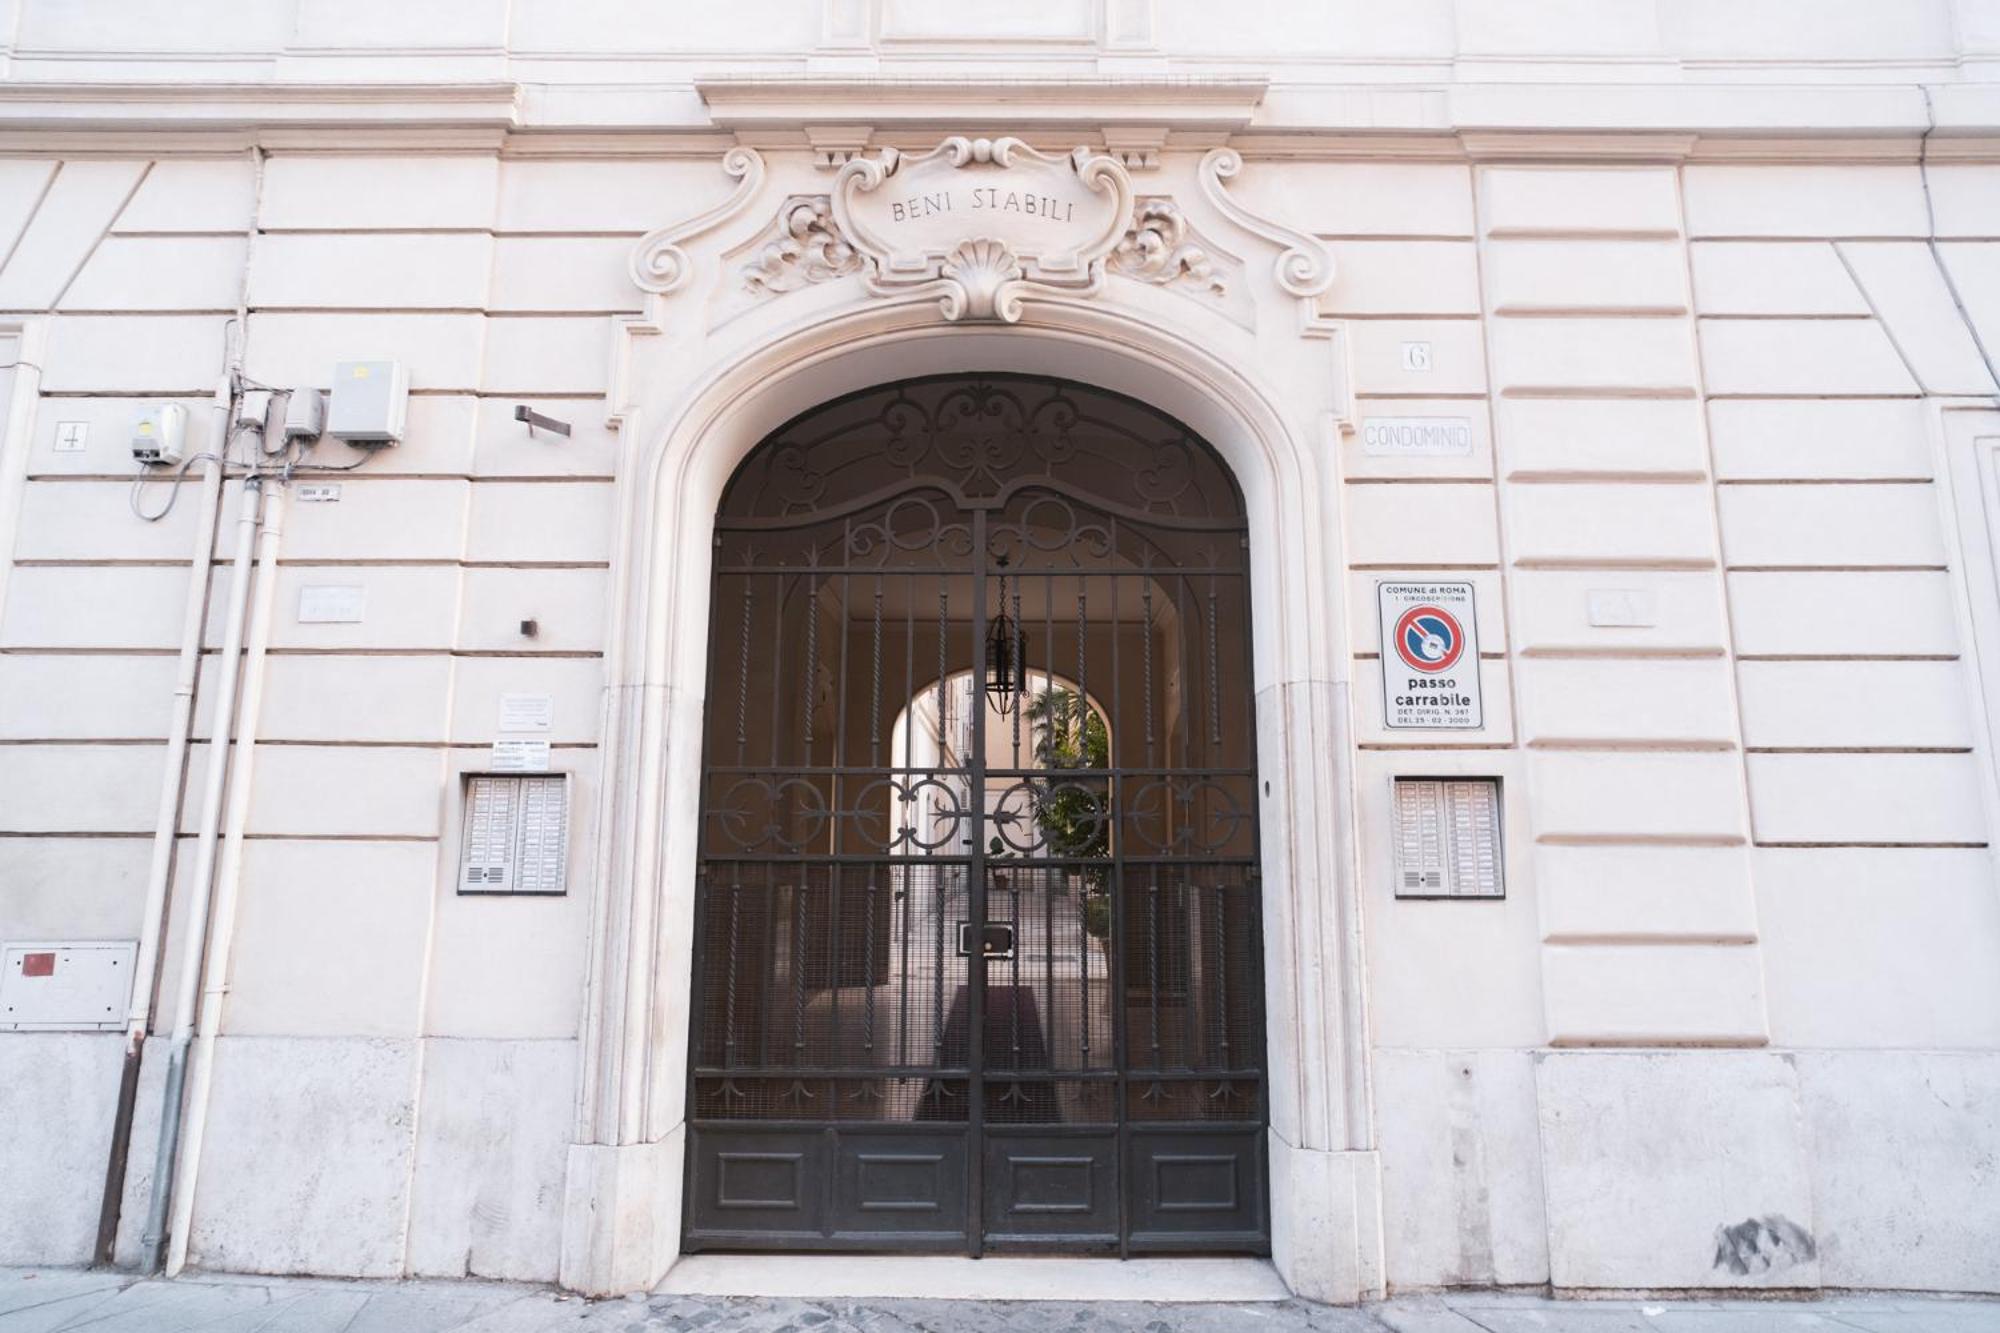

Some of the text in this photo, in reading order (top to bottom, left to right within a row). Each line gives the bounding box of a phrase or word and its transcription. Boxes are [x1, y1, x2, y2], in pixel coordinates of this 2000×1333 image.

[892, 188, 1073, 222] BENI STABILI
[1409, 344, 1426, 369] 6
[1364, 425, 1470, 448] CONDOMINIO
[1386, 586, 1466, 594] COMUNE di ROMA
[1408, 679, 1456, 690] passo
[1395, 693, 1471, 706] carrabile
